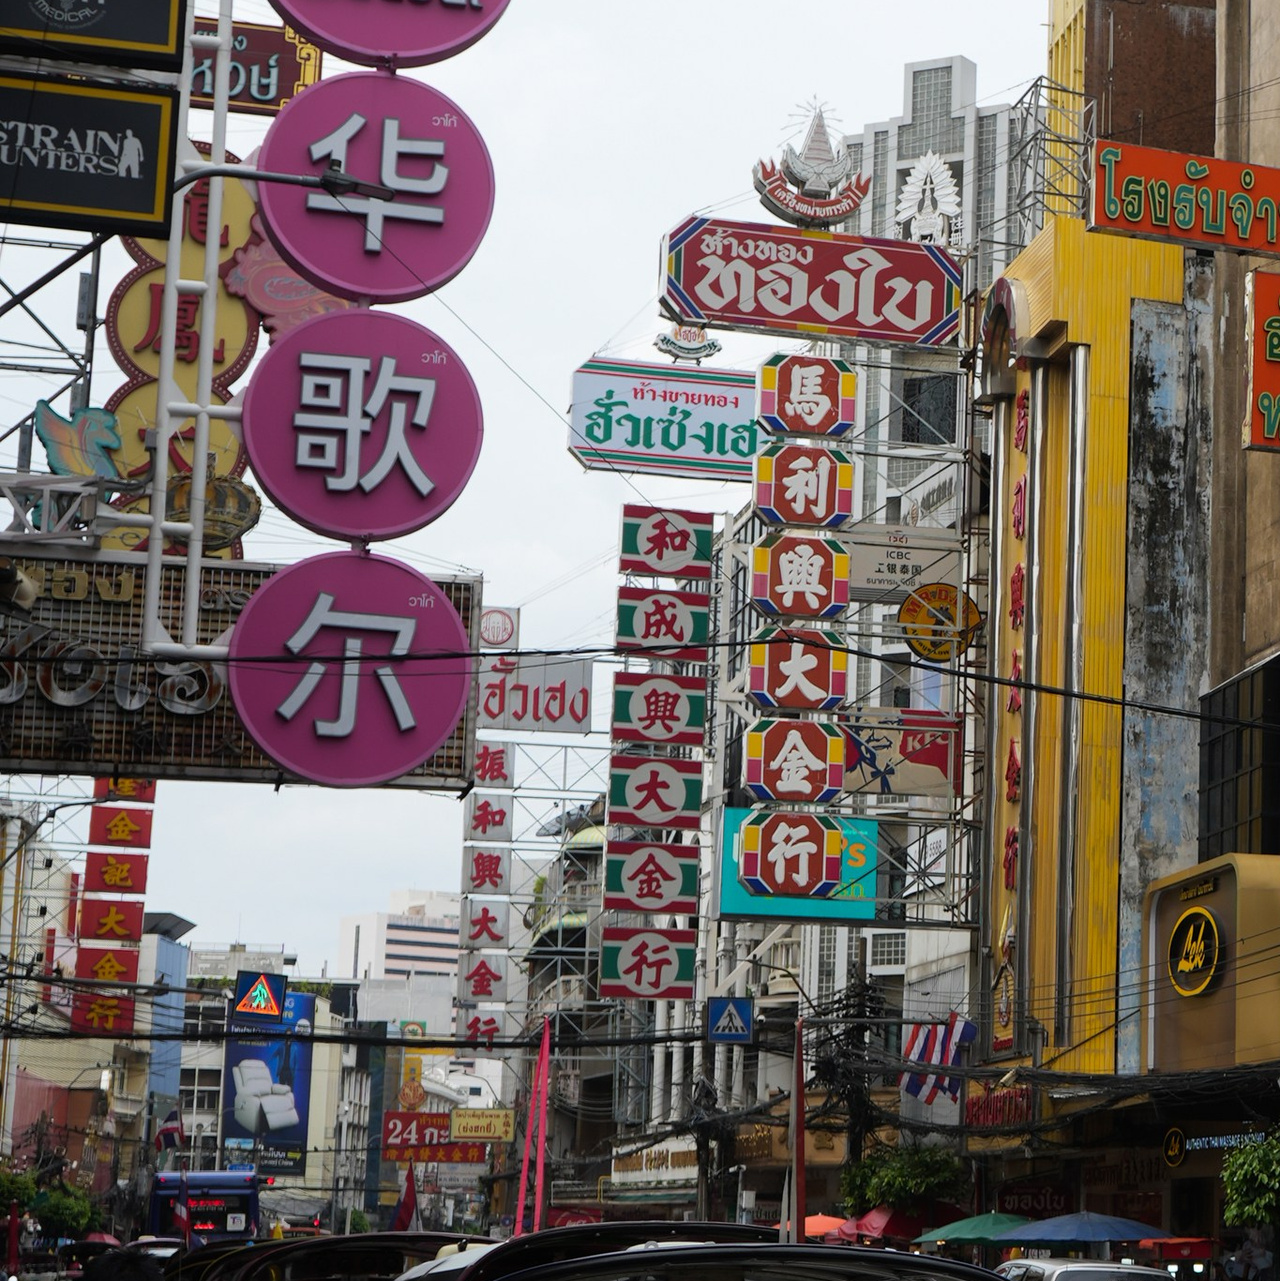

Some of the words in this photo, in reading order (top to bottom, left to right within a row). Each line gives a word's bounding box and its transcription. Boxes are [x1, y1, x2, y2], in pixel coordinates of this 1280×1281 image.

[431, 114, 458, 129] วาโก้
[700, 229, 815, 266] ห้างทอง
[694, 247, 935, 332] ทองใบ
[421, 350, 448, 365] วาโก้
[632, 382, 740, 410] ห้างขายทอง
[584, 389, 785, 458] ฮั่วเซ่งเฮ
[886, 550, 912, 561] ICBC
[874, 563, 923, 575] 工银泰国
[408, 594, 436, 609] วาโก้
[621, 519, 691, 991] 和成興大金行
[906, 730, 950, 754] KFC
[464, 745, 510, 1054] 振和興大金行
[387, 1119, 419, 1145] 24
